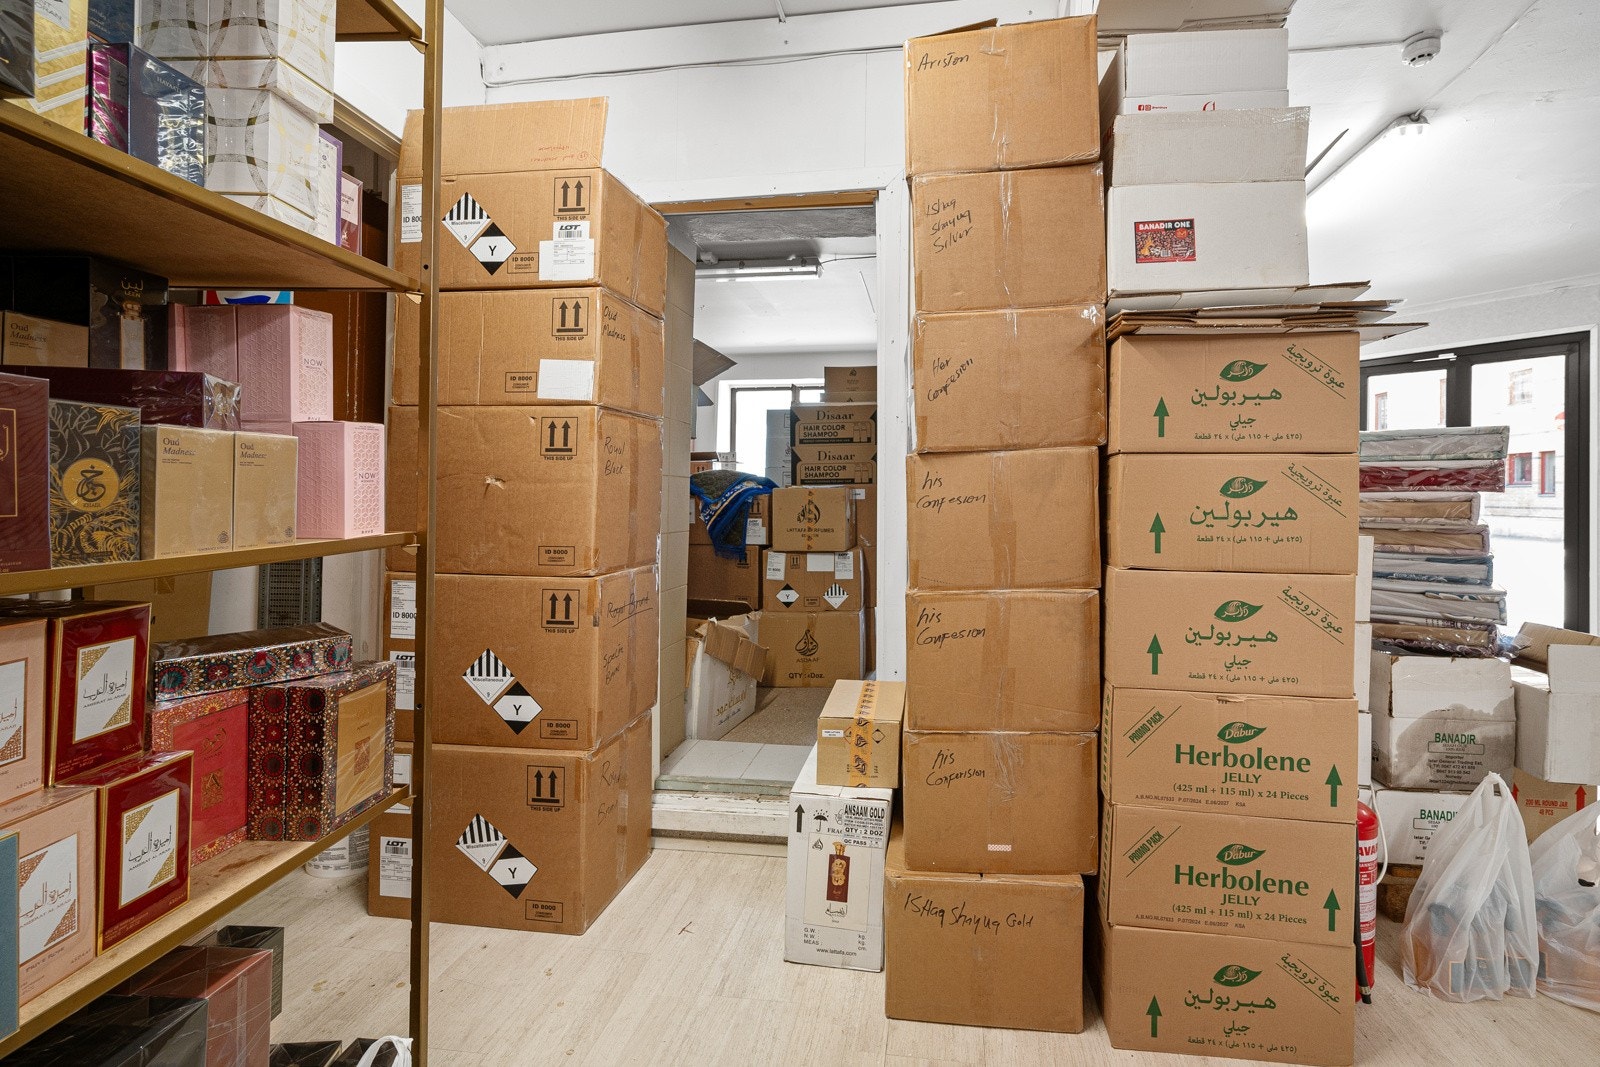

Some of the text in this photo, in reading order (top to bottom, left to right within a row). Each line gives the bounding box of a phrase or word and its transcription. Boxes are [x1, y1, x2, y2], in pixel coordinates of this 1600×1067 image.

[917, 52, 970, 72] Ariston
[1139, 222, 1173, 230] BANADIR
[488, 245, 497, 256] Y
[10, 322, 29, 332] Oud
[303, 358, 323, 367] NOW
[1286, 343, 1345, 390] عبوة ترويجية
[1191, 384, 1282, 407] هيربولين
[816, 410, 854, 421] Disaar
[803, 423, 846, 431] HAIR COLOR
[1229, 414, 1256, 431] جيلي
[803, 430, 838, 438] SHAMPOO
[163, 437, 180, 446] Oud
[240, 442, 254, 450] Oud
[817, 450, 856, 462] Disaar
[824, 464, 847, 472] COLOR
[358, 472, 377, 480] NOW
[804, 471, 840, 479] SHAMPOO
[922, 470, 943, 489] his
[1288, 463, 1343, 507] عبوة ترويجية
[1190, 500, 1298, 528] هيربولين
[392, 611, 400, 619] ID
[1281, 585, 1343, 635] عبوة ترويجية
[916, 607, 942, 628] his
[1185, 624, 1278, 648] هيربولين
[1224, 654, 1252, 671] جيلي
[513, 704, 522, 716] Y
[1129, 710, 1165, 744] PROMO PACK
[1225, 727, 1256, 740] Dabur
[1435, 732, 1476, 744] BANADIR
[1175, 743, 1311, 773] Herbolene
[1222, 772, 1262, 784] JELLY
[1173, 783, 1193, 792] (425
[1195, 785, 1208, 794] ml
[1220, 787, 1236, 795] 115
[1239, 788, 1255, 798] ml)
[1280, 791, 1309, 801] Pieces
[1526, 798, 1534, 806] 200
[844, 804, 885, 819] ANSAAM GOLD
[1129, 830, 1165, 864] PROMO PACK
[1223, 849, 1256, 862] Dabur
[508, 867, 517, 879] Y
[1174, 864, 1309, 896] Herbolene
[1220, 894, 1260, 906] JELLY
[1172, 903, 1307, 924] (425 ml 115 ml) 24 Pieces
[1280, 952, 1340, 1003] عبوة ترويجية
[1184, 988, 1277, 1014] هيربولين
[1223, 1020, 1250, 1037] جيلي
